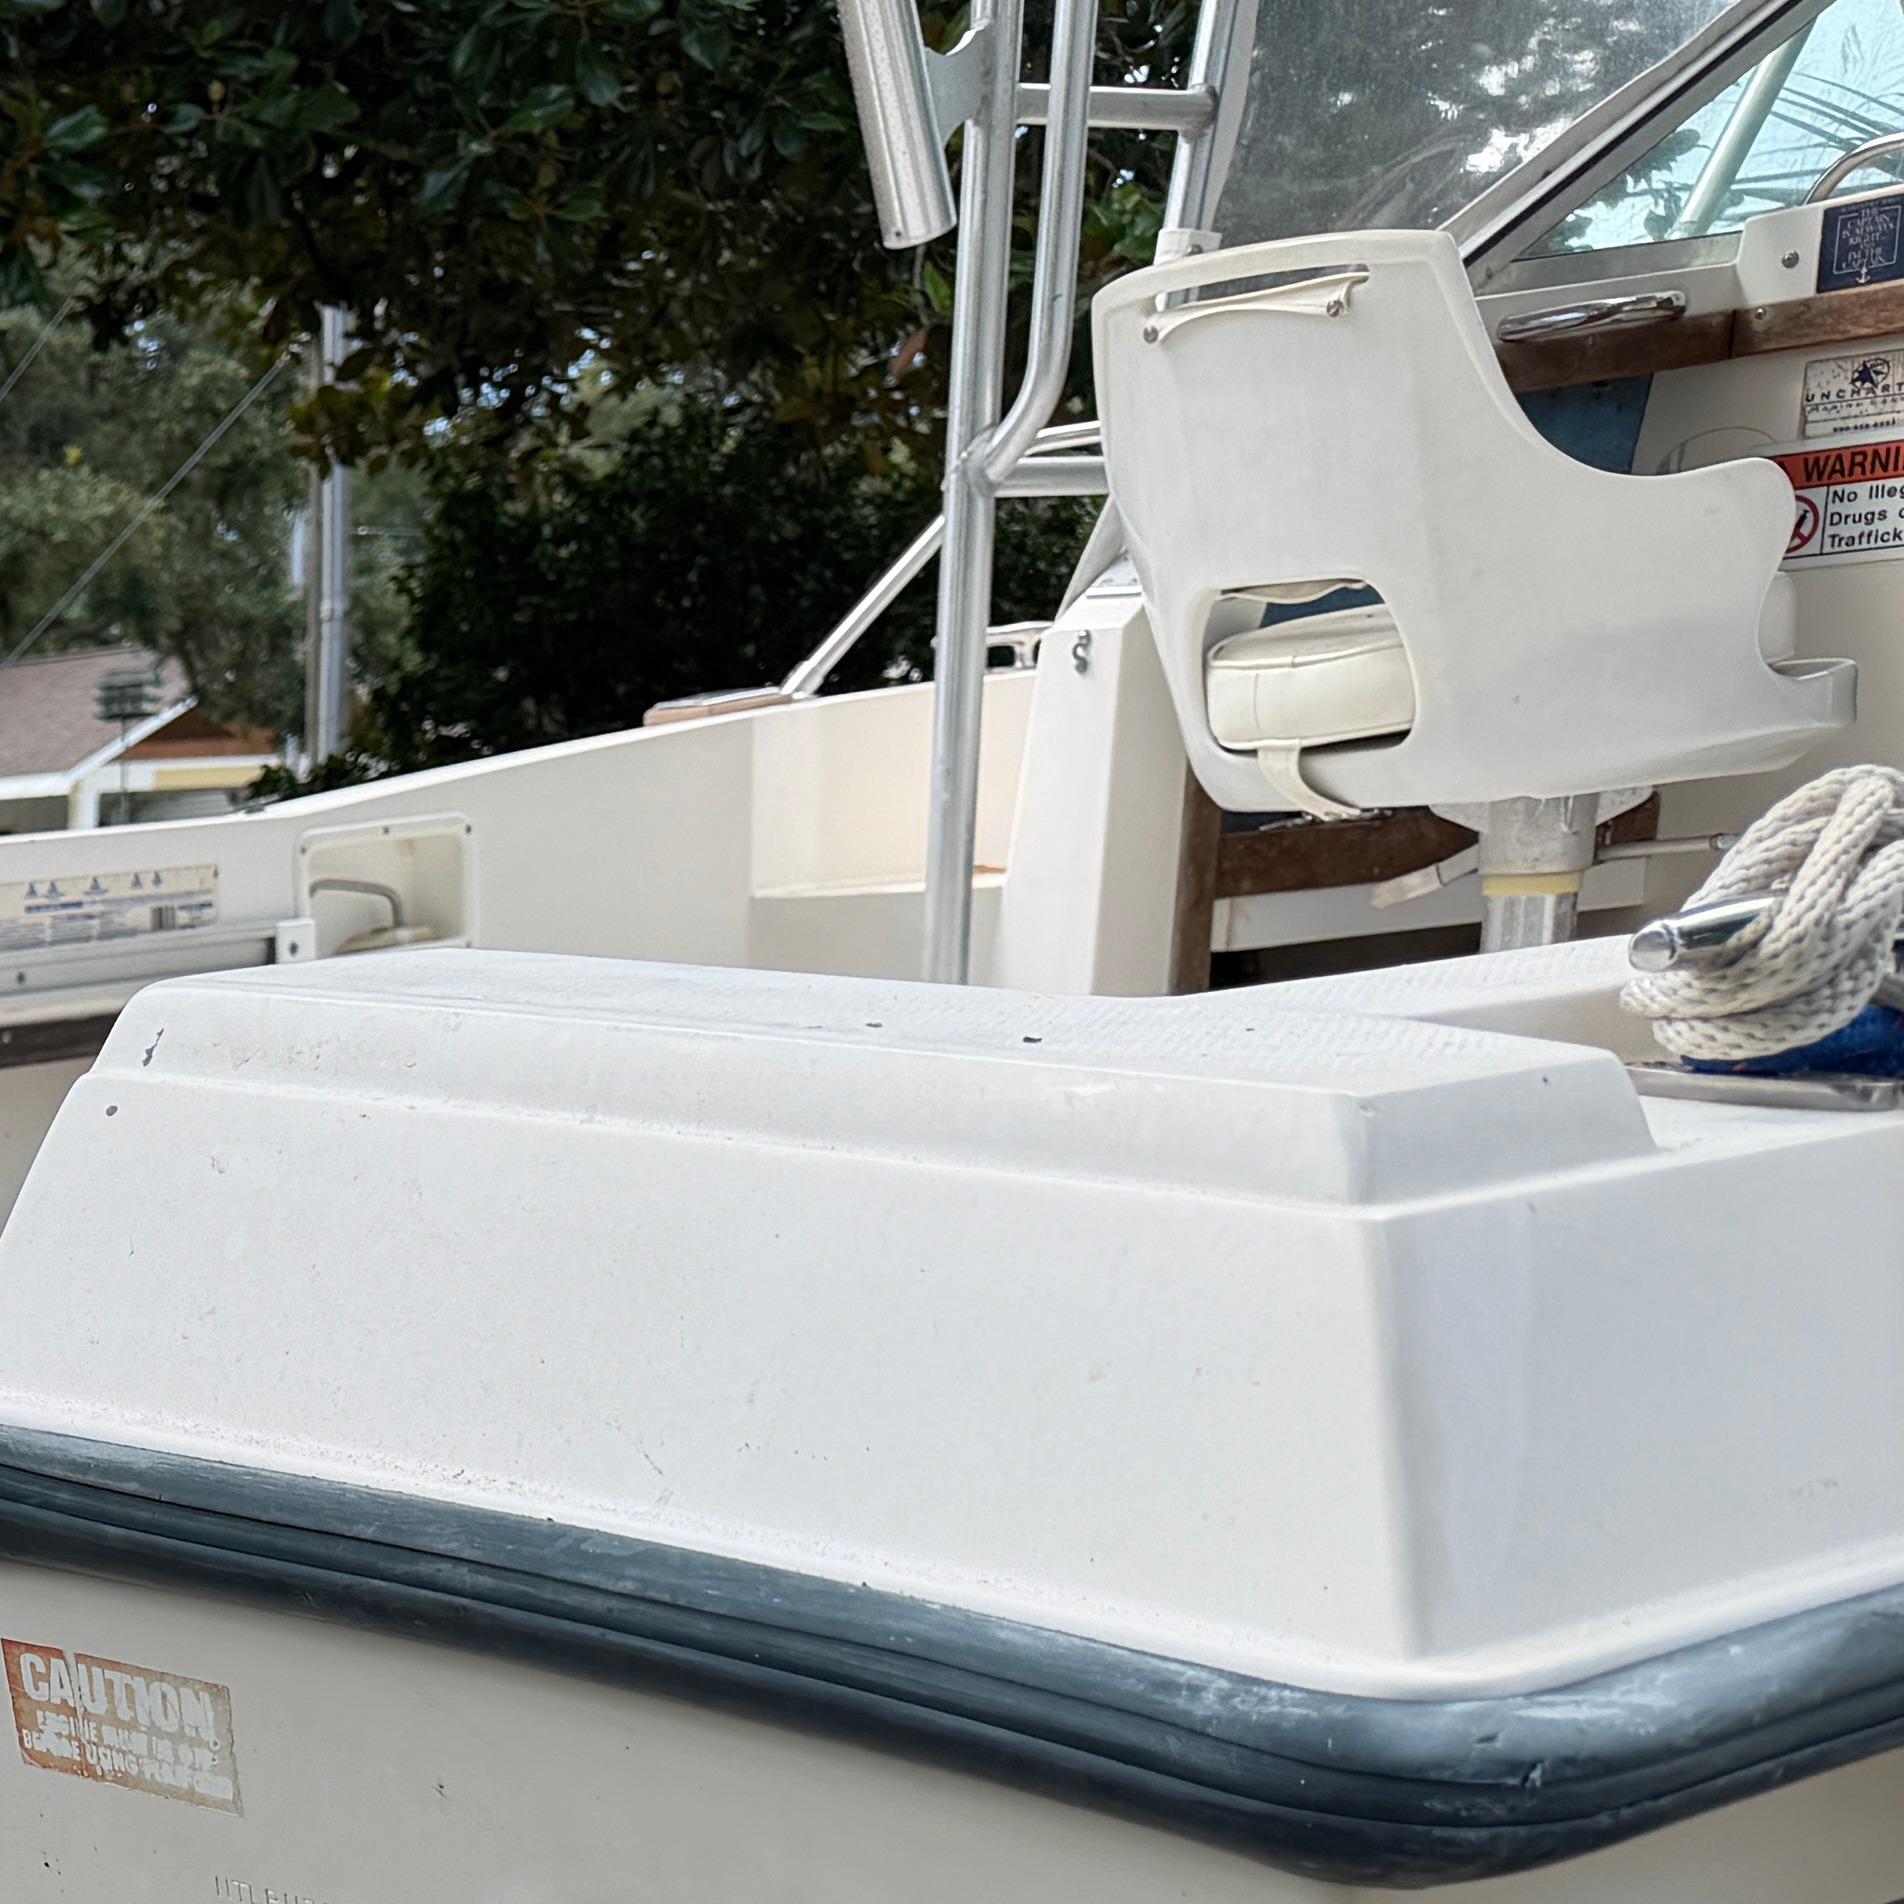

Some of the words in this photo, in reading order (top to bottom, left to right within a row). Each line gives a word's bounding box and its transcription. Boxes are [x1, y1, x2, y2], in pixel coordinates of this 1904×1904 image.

[1803, 446, 1904, 483] WARNI
[1832, 488, 1858, 504] No
[1829, 509, 1888, 526] Drugs
[19, 1652, 215, 1738] CAUTION
